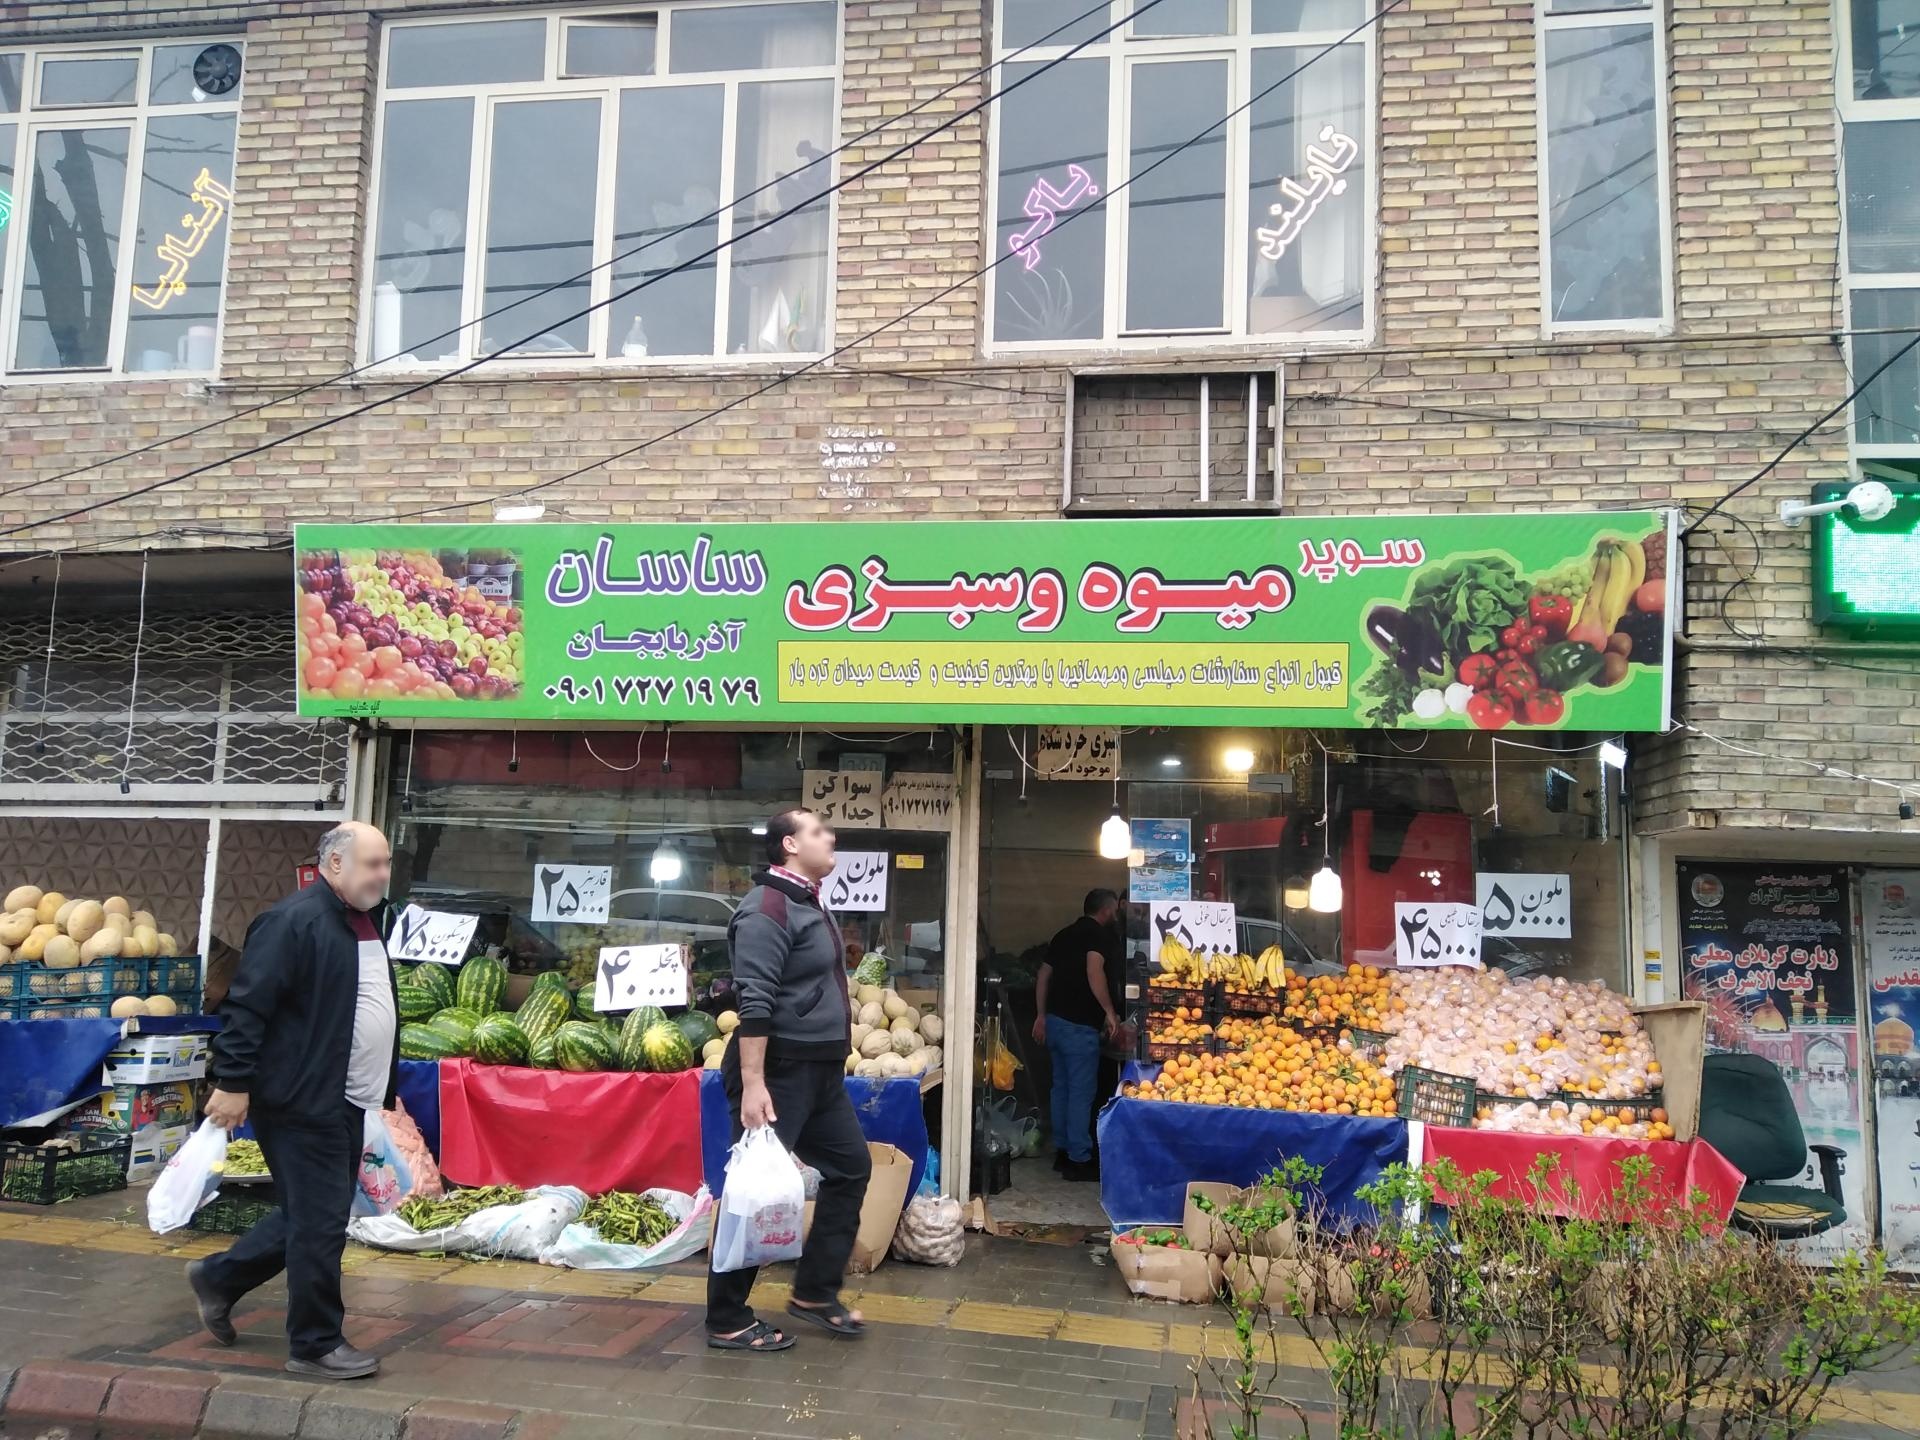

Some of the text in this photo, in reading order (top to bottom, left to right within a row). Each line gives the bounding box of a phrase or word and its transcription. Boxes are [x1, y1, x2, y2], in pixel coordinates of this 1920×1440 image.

[545, 536, 766, 606] ساسان
[1299, 536, 1425, 585] سوپر
[1077, 562, 1295, 633] میوه
[567, 620, 746, 660] آذربایجان
[789, 657, 805, 686] بار
[809, 657, 829, 686] تره
[833, 657, 873, 686] میدان
[878, 658, 921, 688] قیمت
[930, 663, 938, 687] و
[942, 658, 989, 688] کیفیت
[993, 658, 1038, 688] بهترین
[1042, 658, 1054, 688] با
[1132, 658, 1186, 690] مجلسی
[1190, 656, 1259, 690] سفارشات
[1264, 658, 1300, 693] انواع
[1304, 658, 1342, 691] قبول
[544, 675, 760, 704] ۰۹۰۱ ۷۲۷ ۱۹ ۷۹
[1065, 727, 1087, 758] خرد
[1076, 763, 1110, 777] موجود
[813, 776, 838, 799] کن
[844, 776, 871, 800] سوا
[842, 802, 874, 825] جدا
[884, 797, 953, 816] ۰۹۰۱۷۲۷۱۹۷
[847, 853, 884, 884] ملون
[540, 866, 603, 916] ۲۵۰۰۰
[830, 875, 878, 905] ۵۰۰۰
[1521, 878, 1563, 913] ملون
[1211, 908, 1231, 934] پرتقال
[1483, 882, 1566, 931] ۵۰۰۰۰
[399, 911, 458, 959] ۷۵۰۰۰
[1400, 908, 1476, 960] ۴۵۰۰۰
[1457, 911, 1481, 938] پرتقال
[1690, 943, 1839, 970] زیارت کربلای معلی
[601, 950, 675, 1004] ۴۰۰۰۰
[1719, 969, 1813, 995] نجف الاشرف
